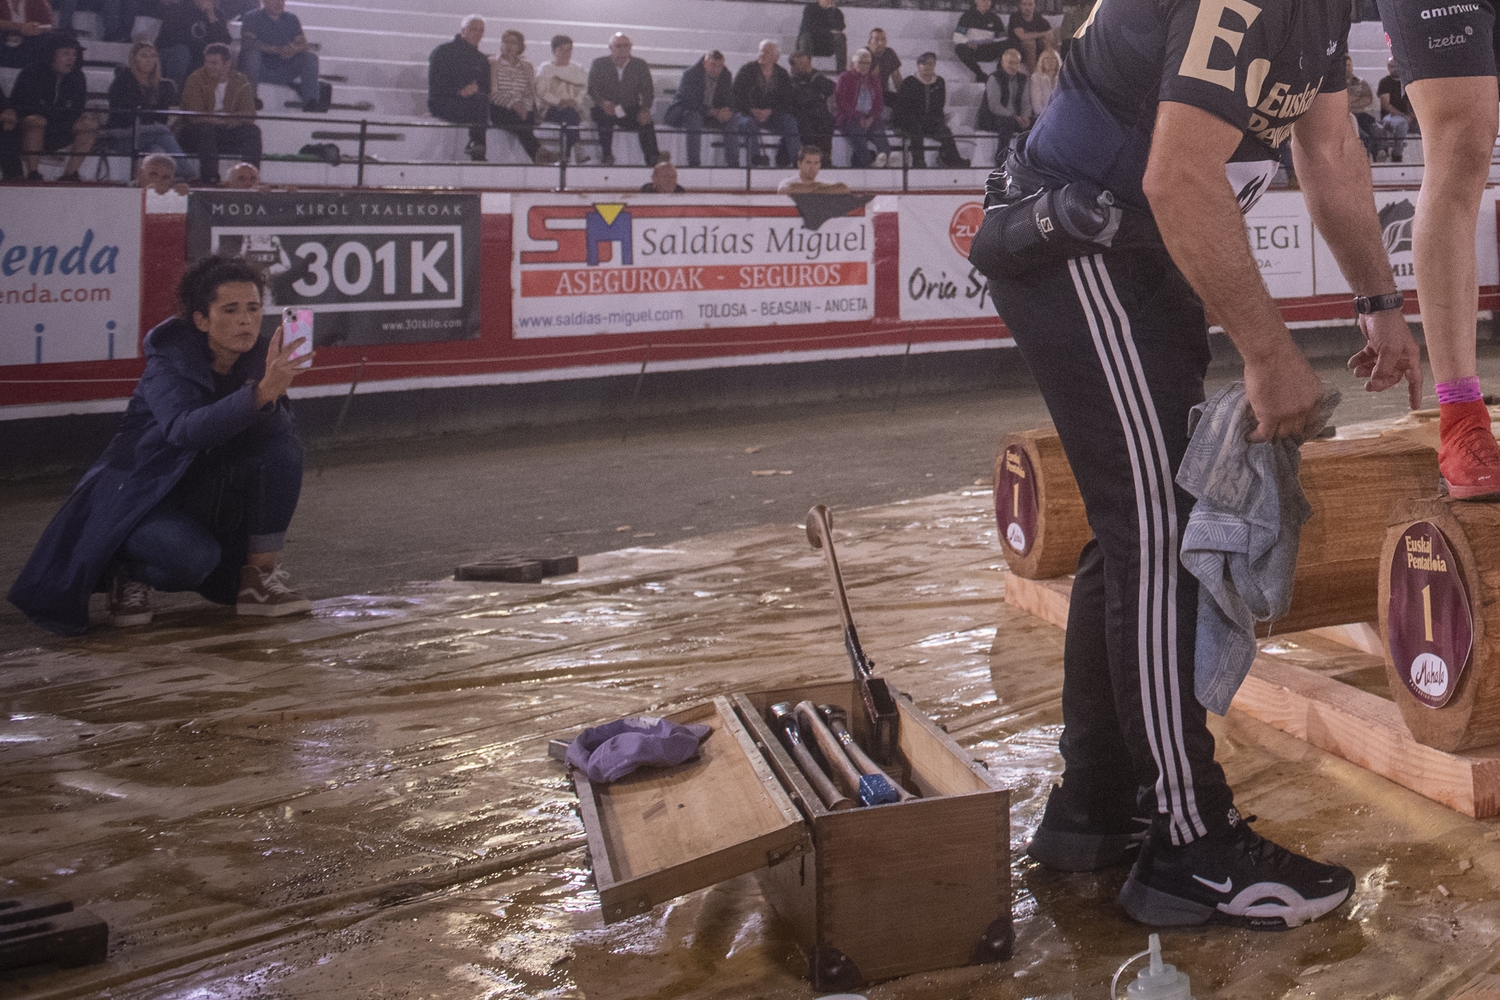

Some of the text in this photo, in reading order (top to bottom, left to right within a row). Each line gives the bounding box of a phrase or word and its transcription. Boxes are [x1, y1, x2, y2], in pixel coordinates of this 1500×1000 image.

[1256, 76, 1323, 119] Euskal
[211, 203, 463, 216] MODA KIROL TXALEKOAK
[641, 225, 866, 260] Saldías Miguel
[555, 267, 704, 295] ASEGUROAK
[739, 263, 841, 288] SEGUROS
[908, 267, 957, 301] Oria
[519, 308, 684, 328] www.saldias-miguel.com
[698, 302, 748, 319] TOLOSA
[760, 300, 811, 316] BEASAIN
[825, 298, 868, 313] ANOETA
[1405, 535, 1433, 553] Euskal
[1422, 584, 1434, 642] 1
